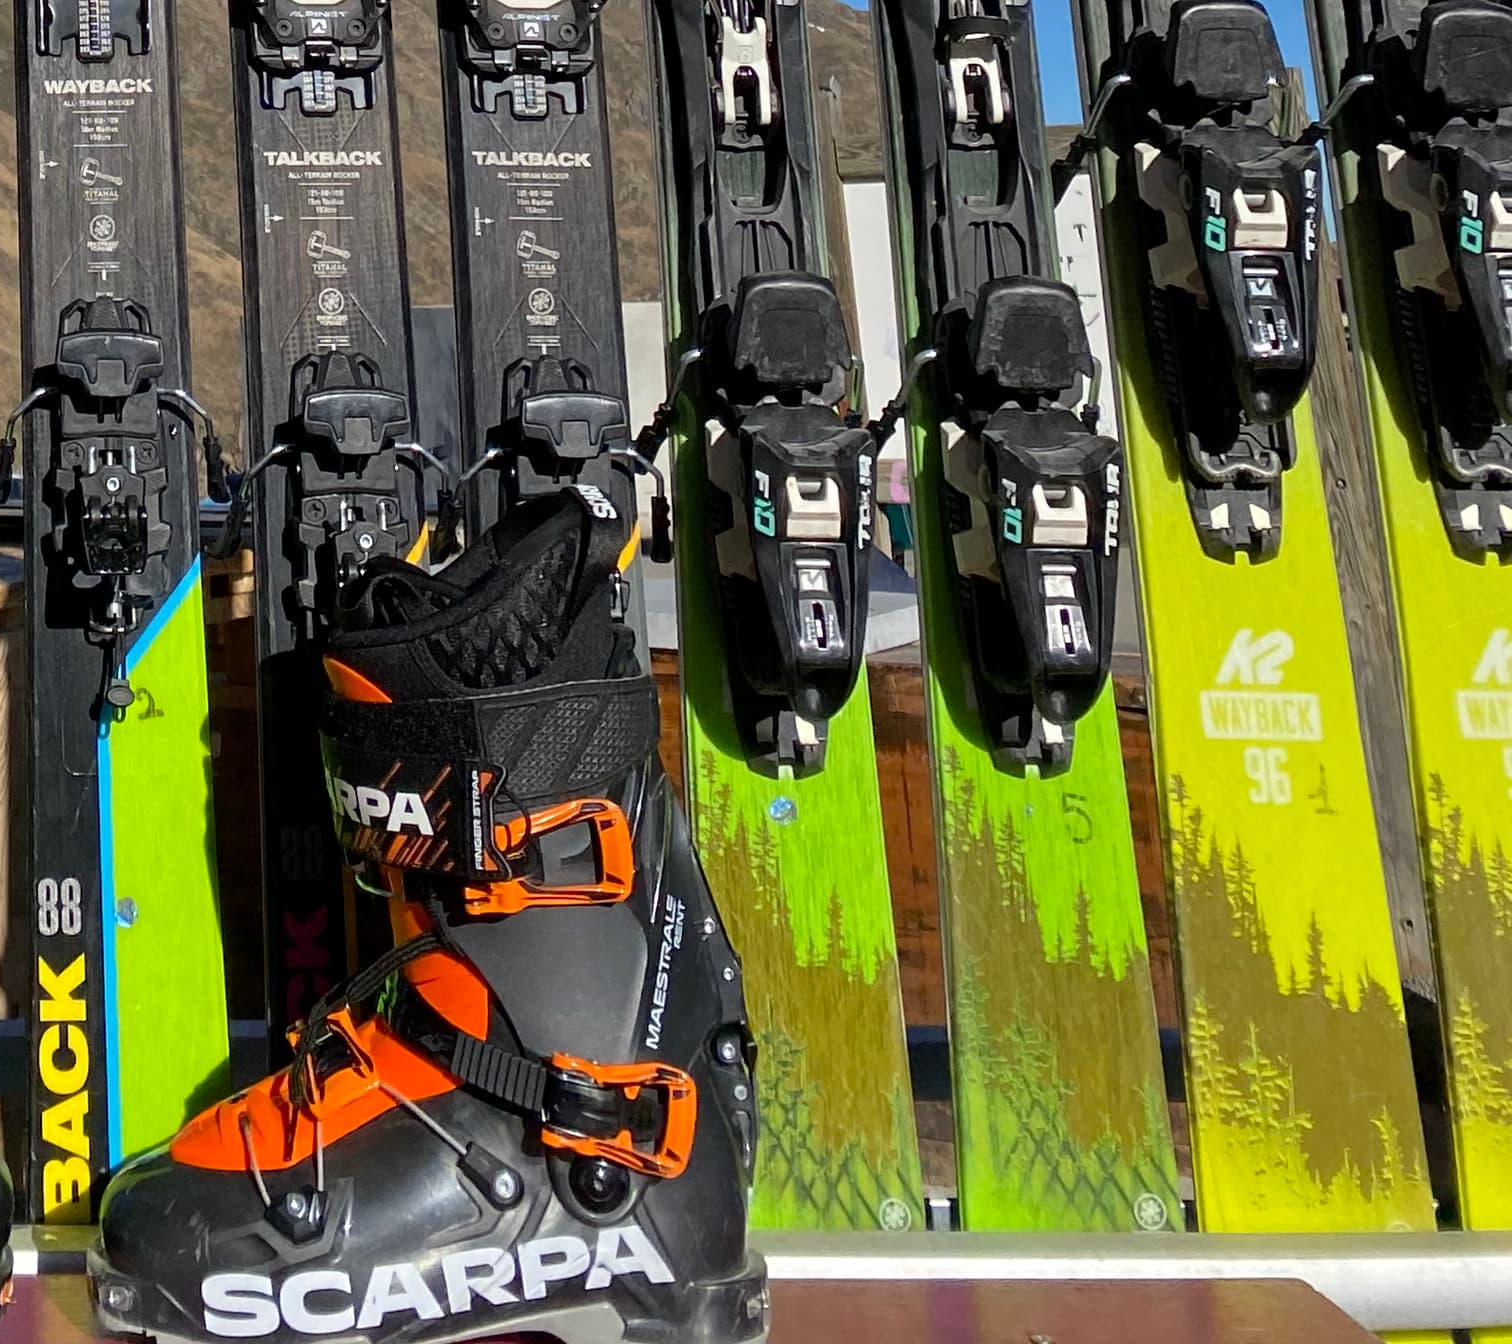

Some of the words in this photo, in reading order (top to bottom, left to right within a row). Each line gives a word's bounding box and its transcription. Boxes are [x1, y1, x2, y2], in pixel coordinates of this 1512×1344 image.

[44, 79, 153, 94] WAYBACK
[264, 151, 382, 166] TALKBACK
[472, 151, 592, 167] TALKBACK
[1215, 628, 1294, 685] K2
[1209, 697, 1314, 735] WAYBACK
[471, 770, 481, 817] STRAP
[1244, 746, 1292, 805] 96
[472, 819, 484, 871] FINGER
[1062, 793, 1093, 845] 5
[37, 877, 83, 937] 88
[673, 899, 686, 950] RENT
[646, 894, 677, 1050] MAESTRALE
[39, 953, 90, 1224] BACK
[201, 1225, 675, 1339] SCARPA
